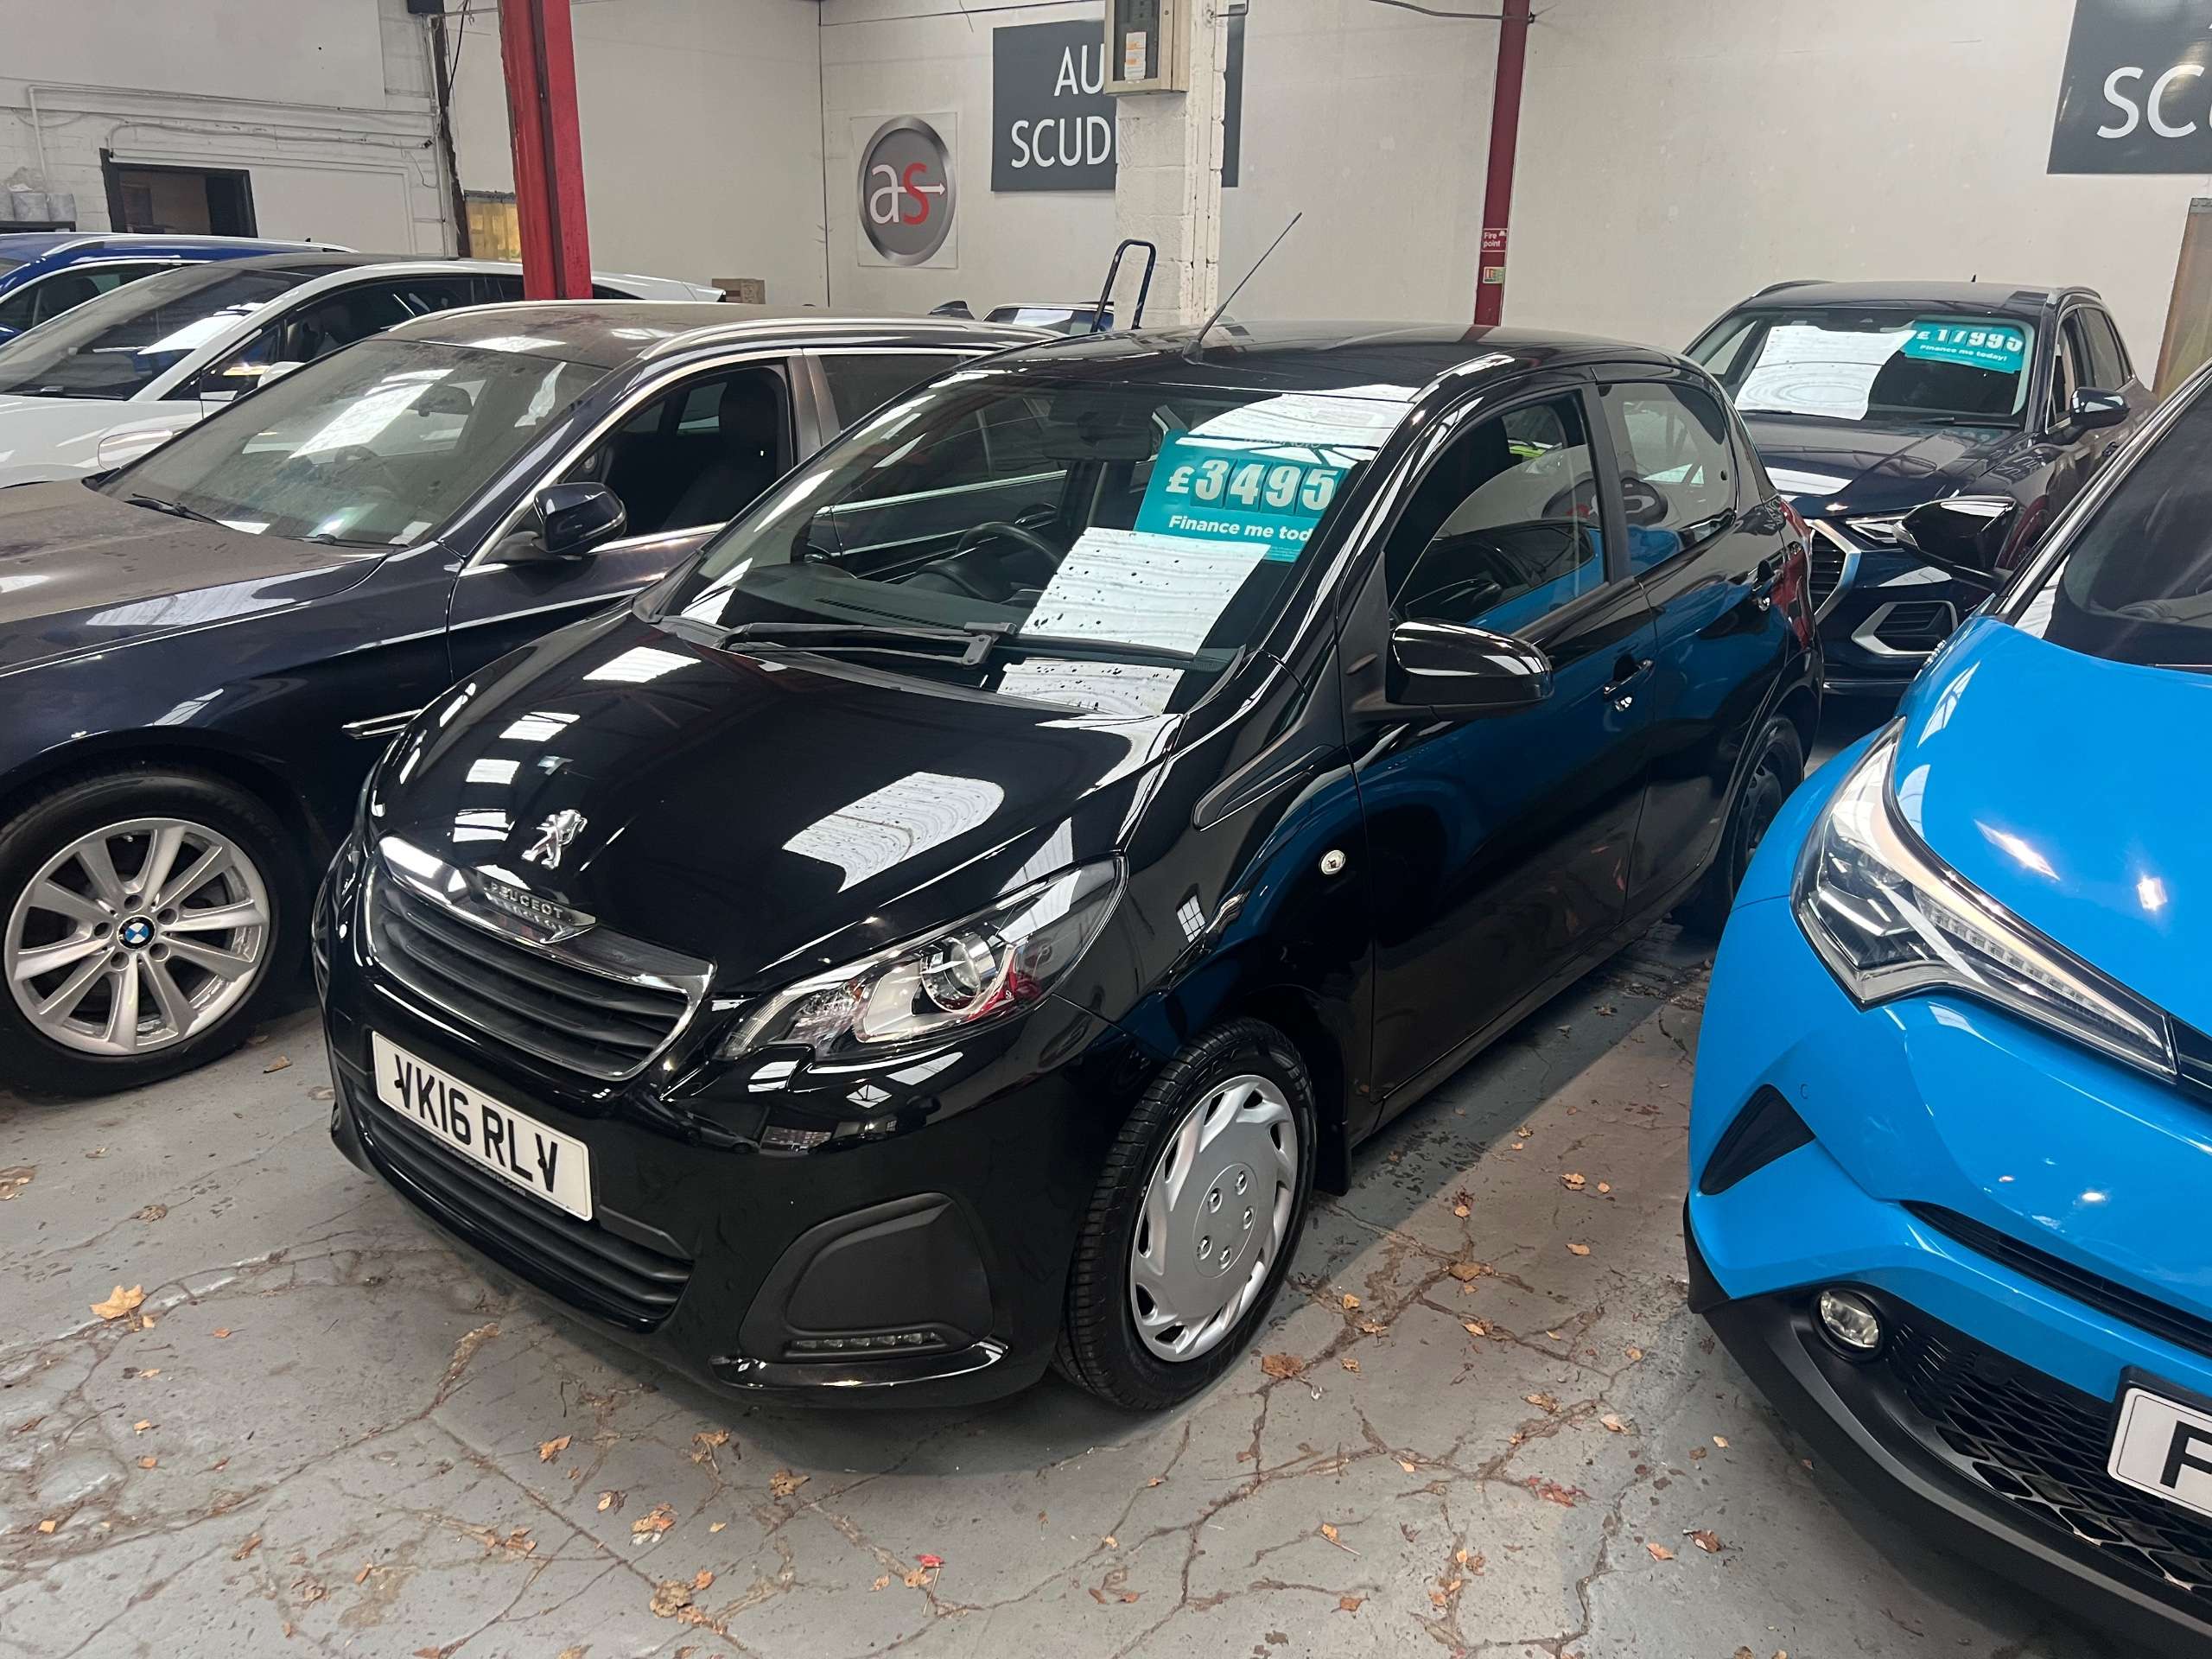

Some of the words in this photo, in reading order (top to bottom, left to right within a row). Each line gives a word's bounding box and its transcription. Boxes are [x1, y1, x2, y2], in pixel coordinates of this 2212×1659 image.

[2096, 64, 2212, 139] SC
[1010, 116, 1120, 168] SCUD
[1483, 240, 1501, 249] point
[1920, 344, 1957, 353] Finance
[1976, 351, 2007, 361] today!
[1166, 459, 1338, 511] £3495
[1168, 514, 1240, 535] Finance
[1244, 524, 1274, 538] me
[491, 881, 563, 918] PEUGEOT
[394, 1054, 472, 1147] VK16
[481, 1107, 559, 1193] RLV
